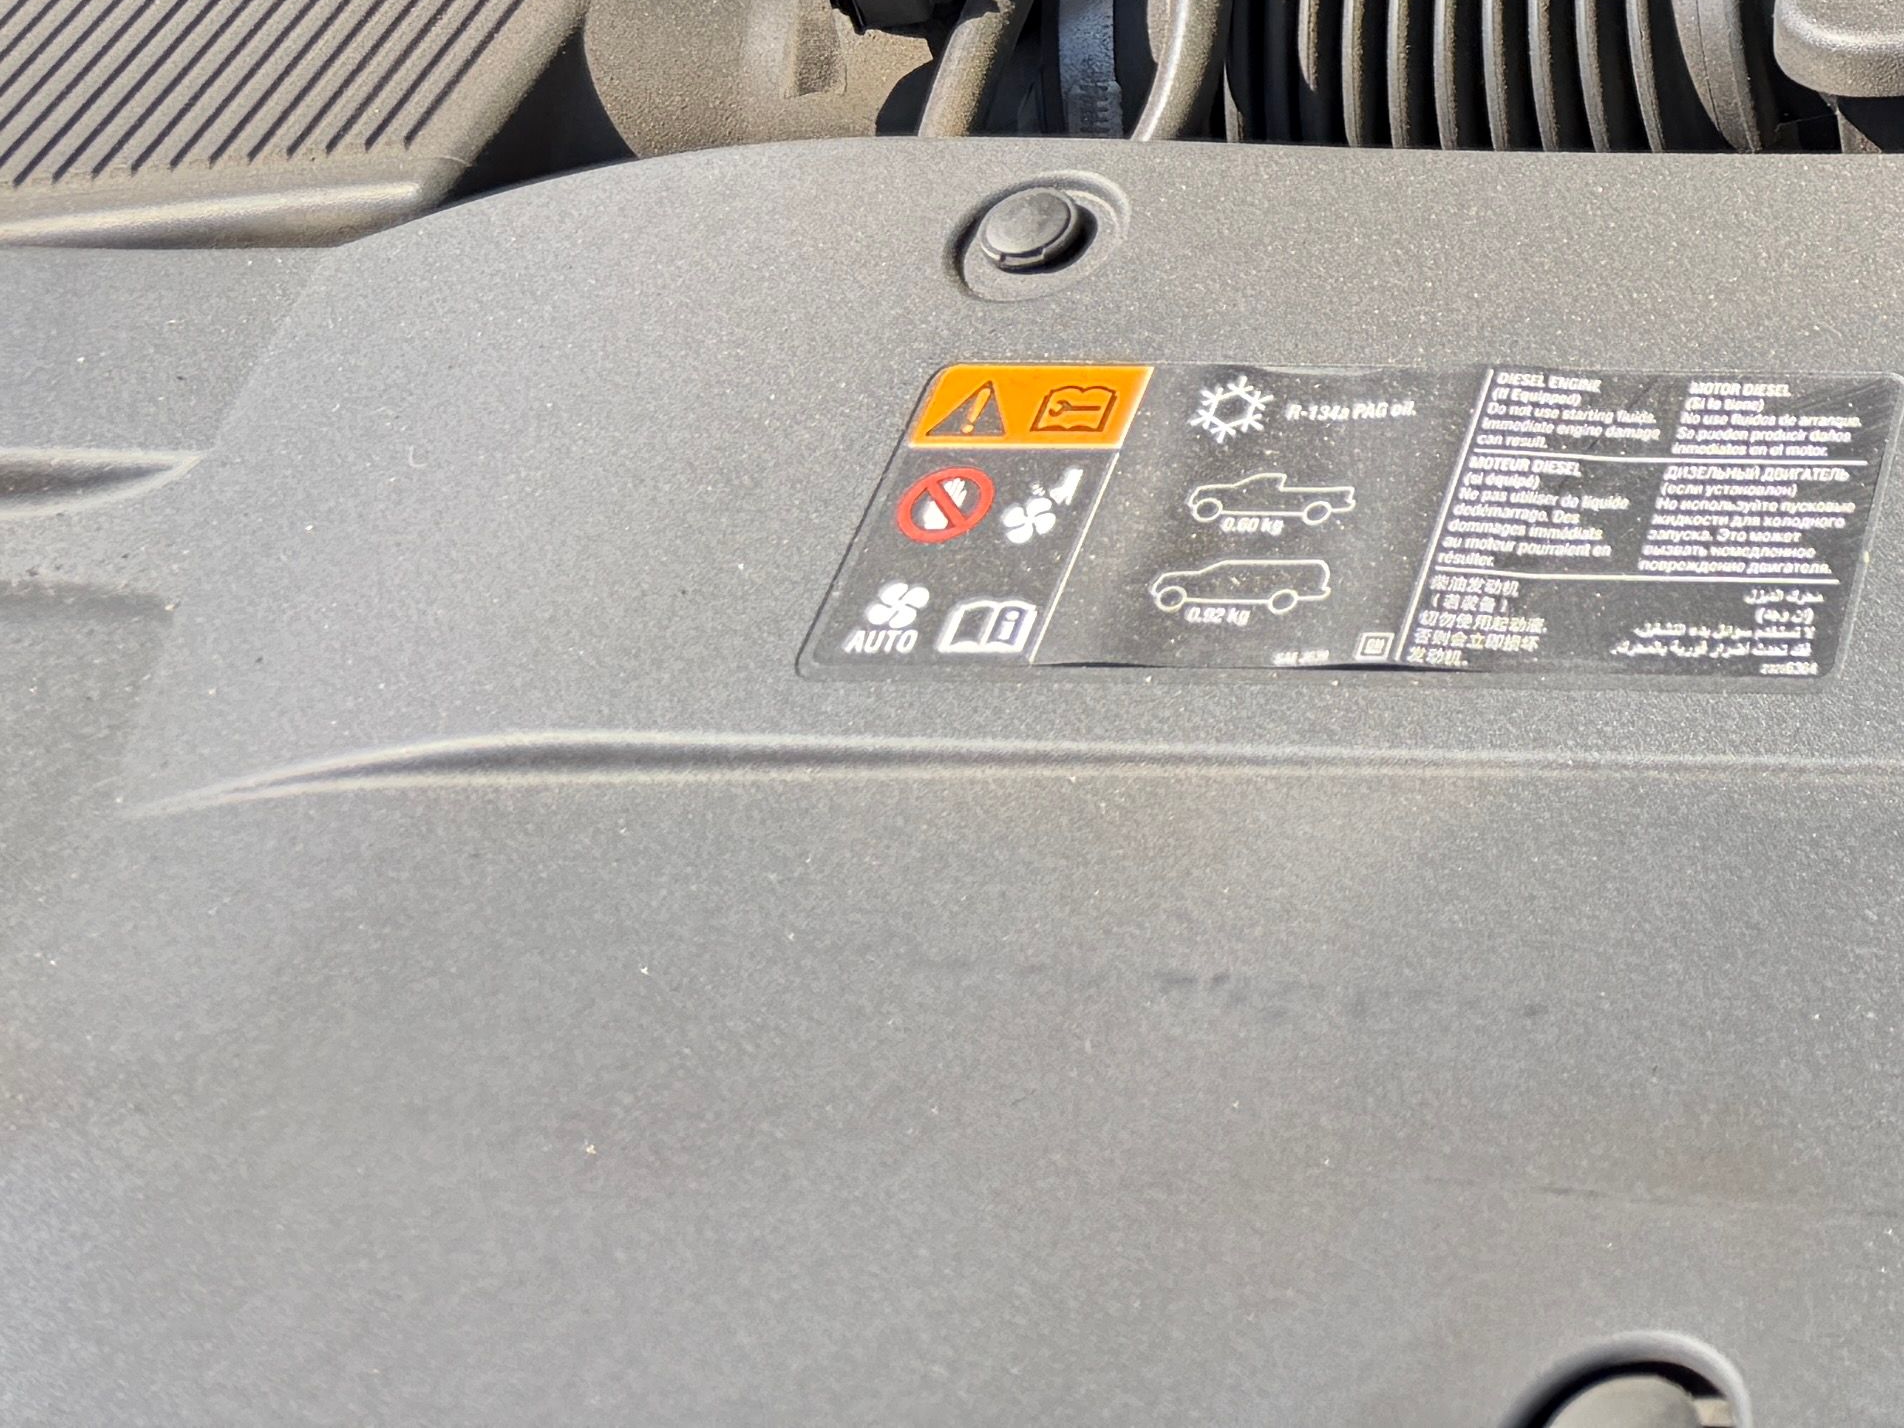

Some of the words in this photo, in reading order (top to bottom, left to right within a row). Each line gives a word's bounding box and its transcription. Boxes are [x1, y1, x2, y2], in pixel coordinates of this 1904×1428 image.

[1497, 371, 1546, 388] DIESEL
[1548, 375, 1603, 393] ENGINE
[1689, 381, 1742, 395] MOTOR
[1743, 383, 1792, 397] DIESEL
[1511, 389, 1582, 406] Equipped)
[1286, 403, 1350, 421] R-134a
[1352, 401, 1389, 420] PAG
[1390, 400, 1417, 417] oil.
[1487, 402, 1507, 415] Do
[1509, 403, 1533, 417] not
[1534, 407, 1560, 419] use
[1562, 408, 1614, 424] starting
[1616, 410, 1657, 424] fluids.
[1481, 417, 1555, 434] Immediate
[1556, 422, 1604, 438] engine
[1605, 425, 1662, 441] damage
[1680, 412, 1700, 425] No
[1702, 414, 1729, 425] use
[1731, 413, 1777, 426] fluidos
[1778, 414, 1798, 426] de
[1799, 415, 1862, 429] arranque.
[1476, 434, 1504, 446] can
[1505, 435, 1549, 449] result.
[1697, 429, 1749, 442] pueden
[1750, 429, 1808, 443] producir
[1749, 445, 1768, 456] en
[1769, 444, 1784, 456] el
[1785, 445, 1828, 457] motor.
[1469, 455, 1531, 472] MOTEUR
[1531, 459, 1582, 477] DIESEL
[1663, 464, 1761, 481] ДИЗЕЛЬНЫЙ
[1761, 467, 1850, 482] ДВИГАТЕЛЬ
[1458, 487, 1479, 501] Ne
[1480, 489, 1508, 502] pas
[1510, 491, 1559, 506] utiliser
[1560, 495, 1580, 508] de
[1581, 495, 1630, 511] liquide
[1655, 497, 1678, 510] Не
[1220, 516, 1260, 533] 0.60
[1260, 517, 1285, 537] kg
[1551, 510, 1581, 524] Des
[1651, 513, 1729, 528] жидкости
[1730, 515, 1761, 528] для
[1762, 517, 1846, 530] холодного
[1447, 518, 1526, 537] dommages
[1716, 527, 1748, 542] Это
[1441, 535, 1463, 548] au
[1464, 537, 1517, 553] moteur
[1516, 541, 1591, 557] pourraient
[1591, 545, 1613, 557] en
[1429, 574, 1520, 598] 柴油发动机
[1185, 606, 1227, 624] 0.92
[1226, 607, 1251, 626] kg
[843, 629, 919, 654] AUTO
